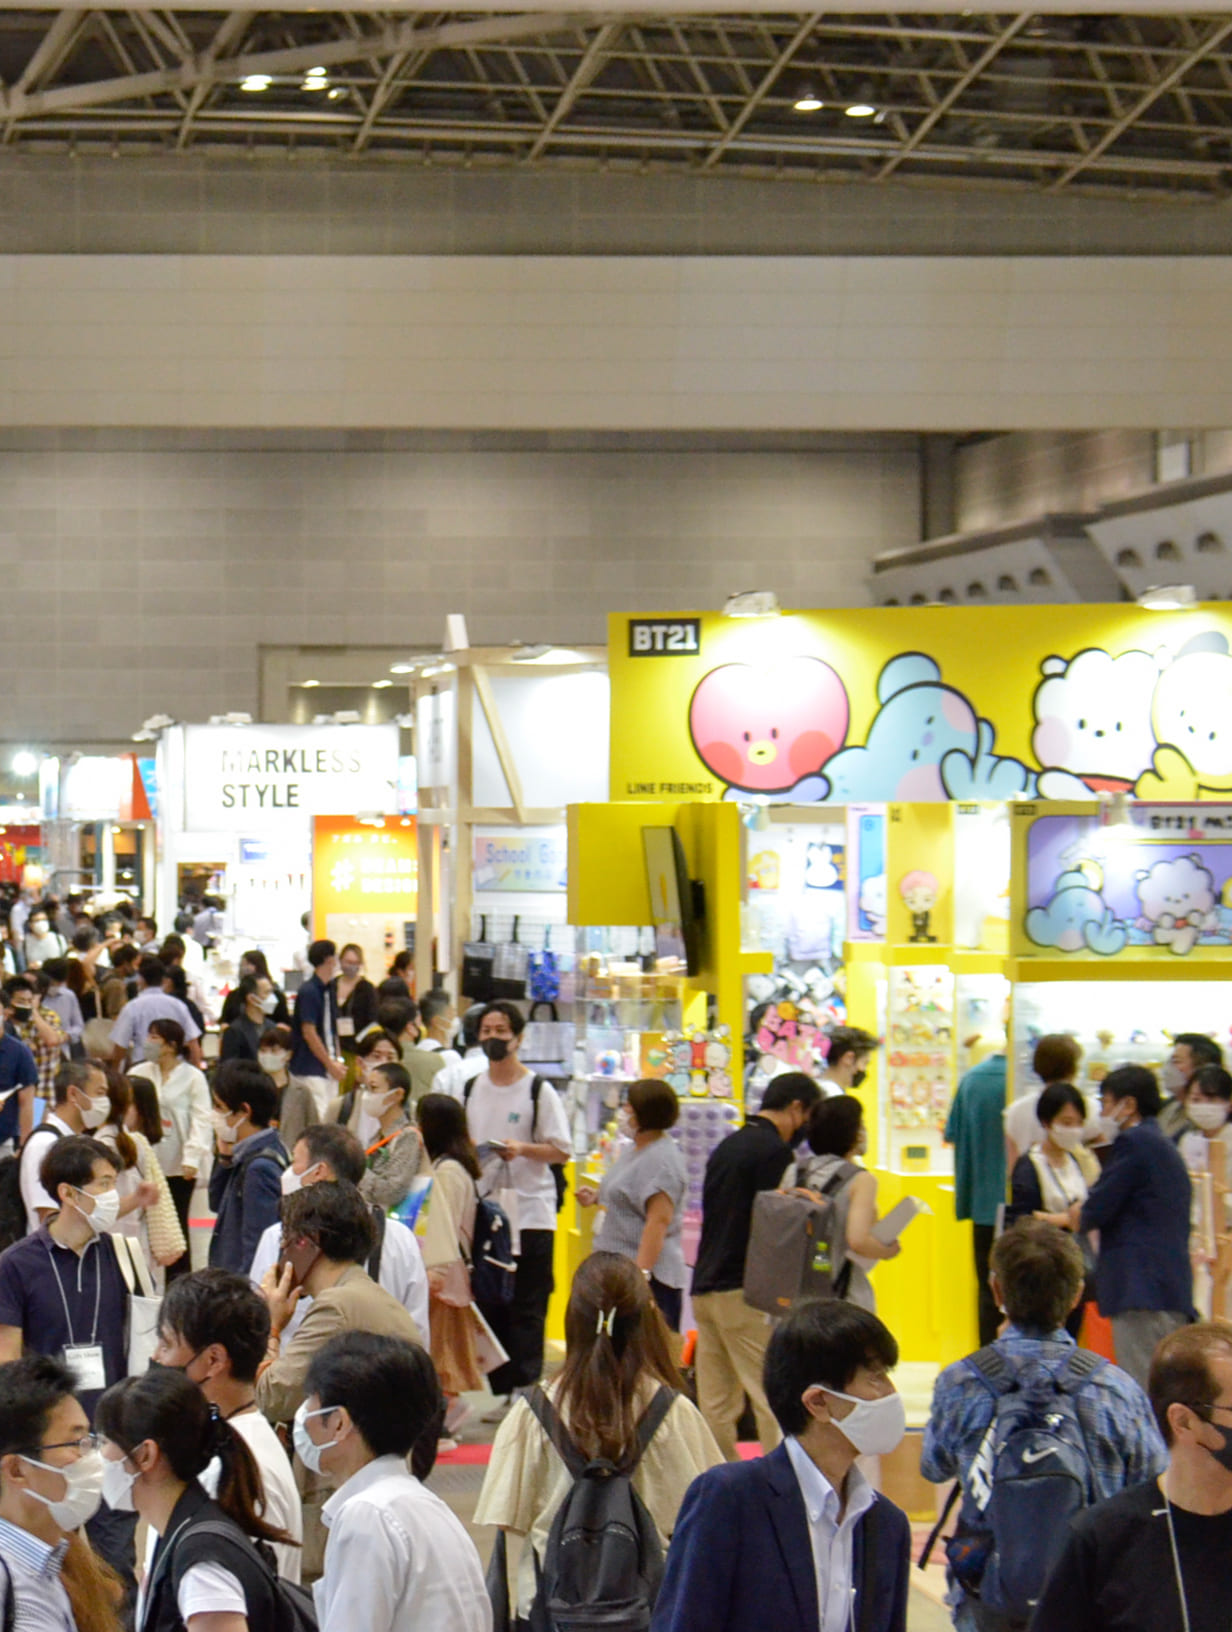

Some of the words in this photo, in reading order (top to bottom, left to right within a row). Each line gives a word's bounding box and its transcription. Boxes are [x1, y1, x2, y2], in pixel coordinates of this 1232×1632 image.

[632, 624, 699, 652] BT21
[221, 749, 362, 774] MARKLESS
[221, 783, 300, 808] STYLE
[627, 782, 656, 796] LINE
[660, 782, 713, 796] FRIENDS
